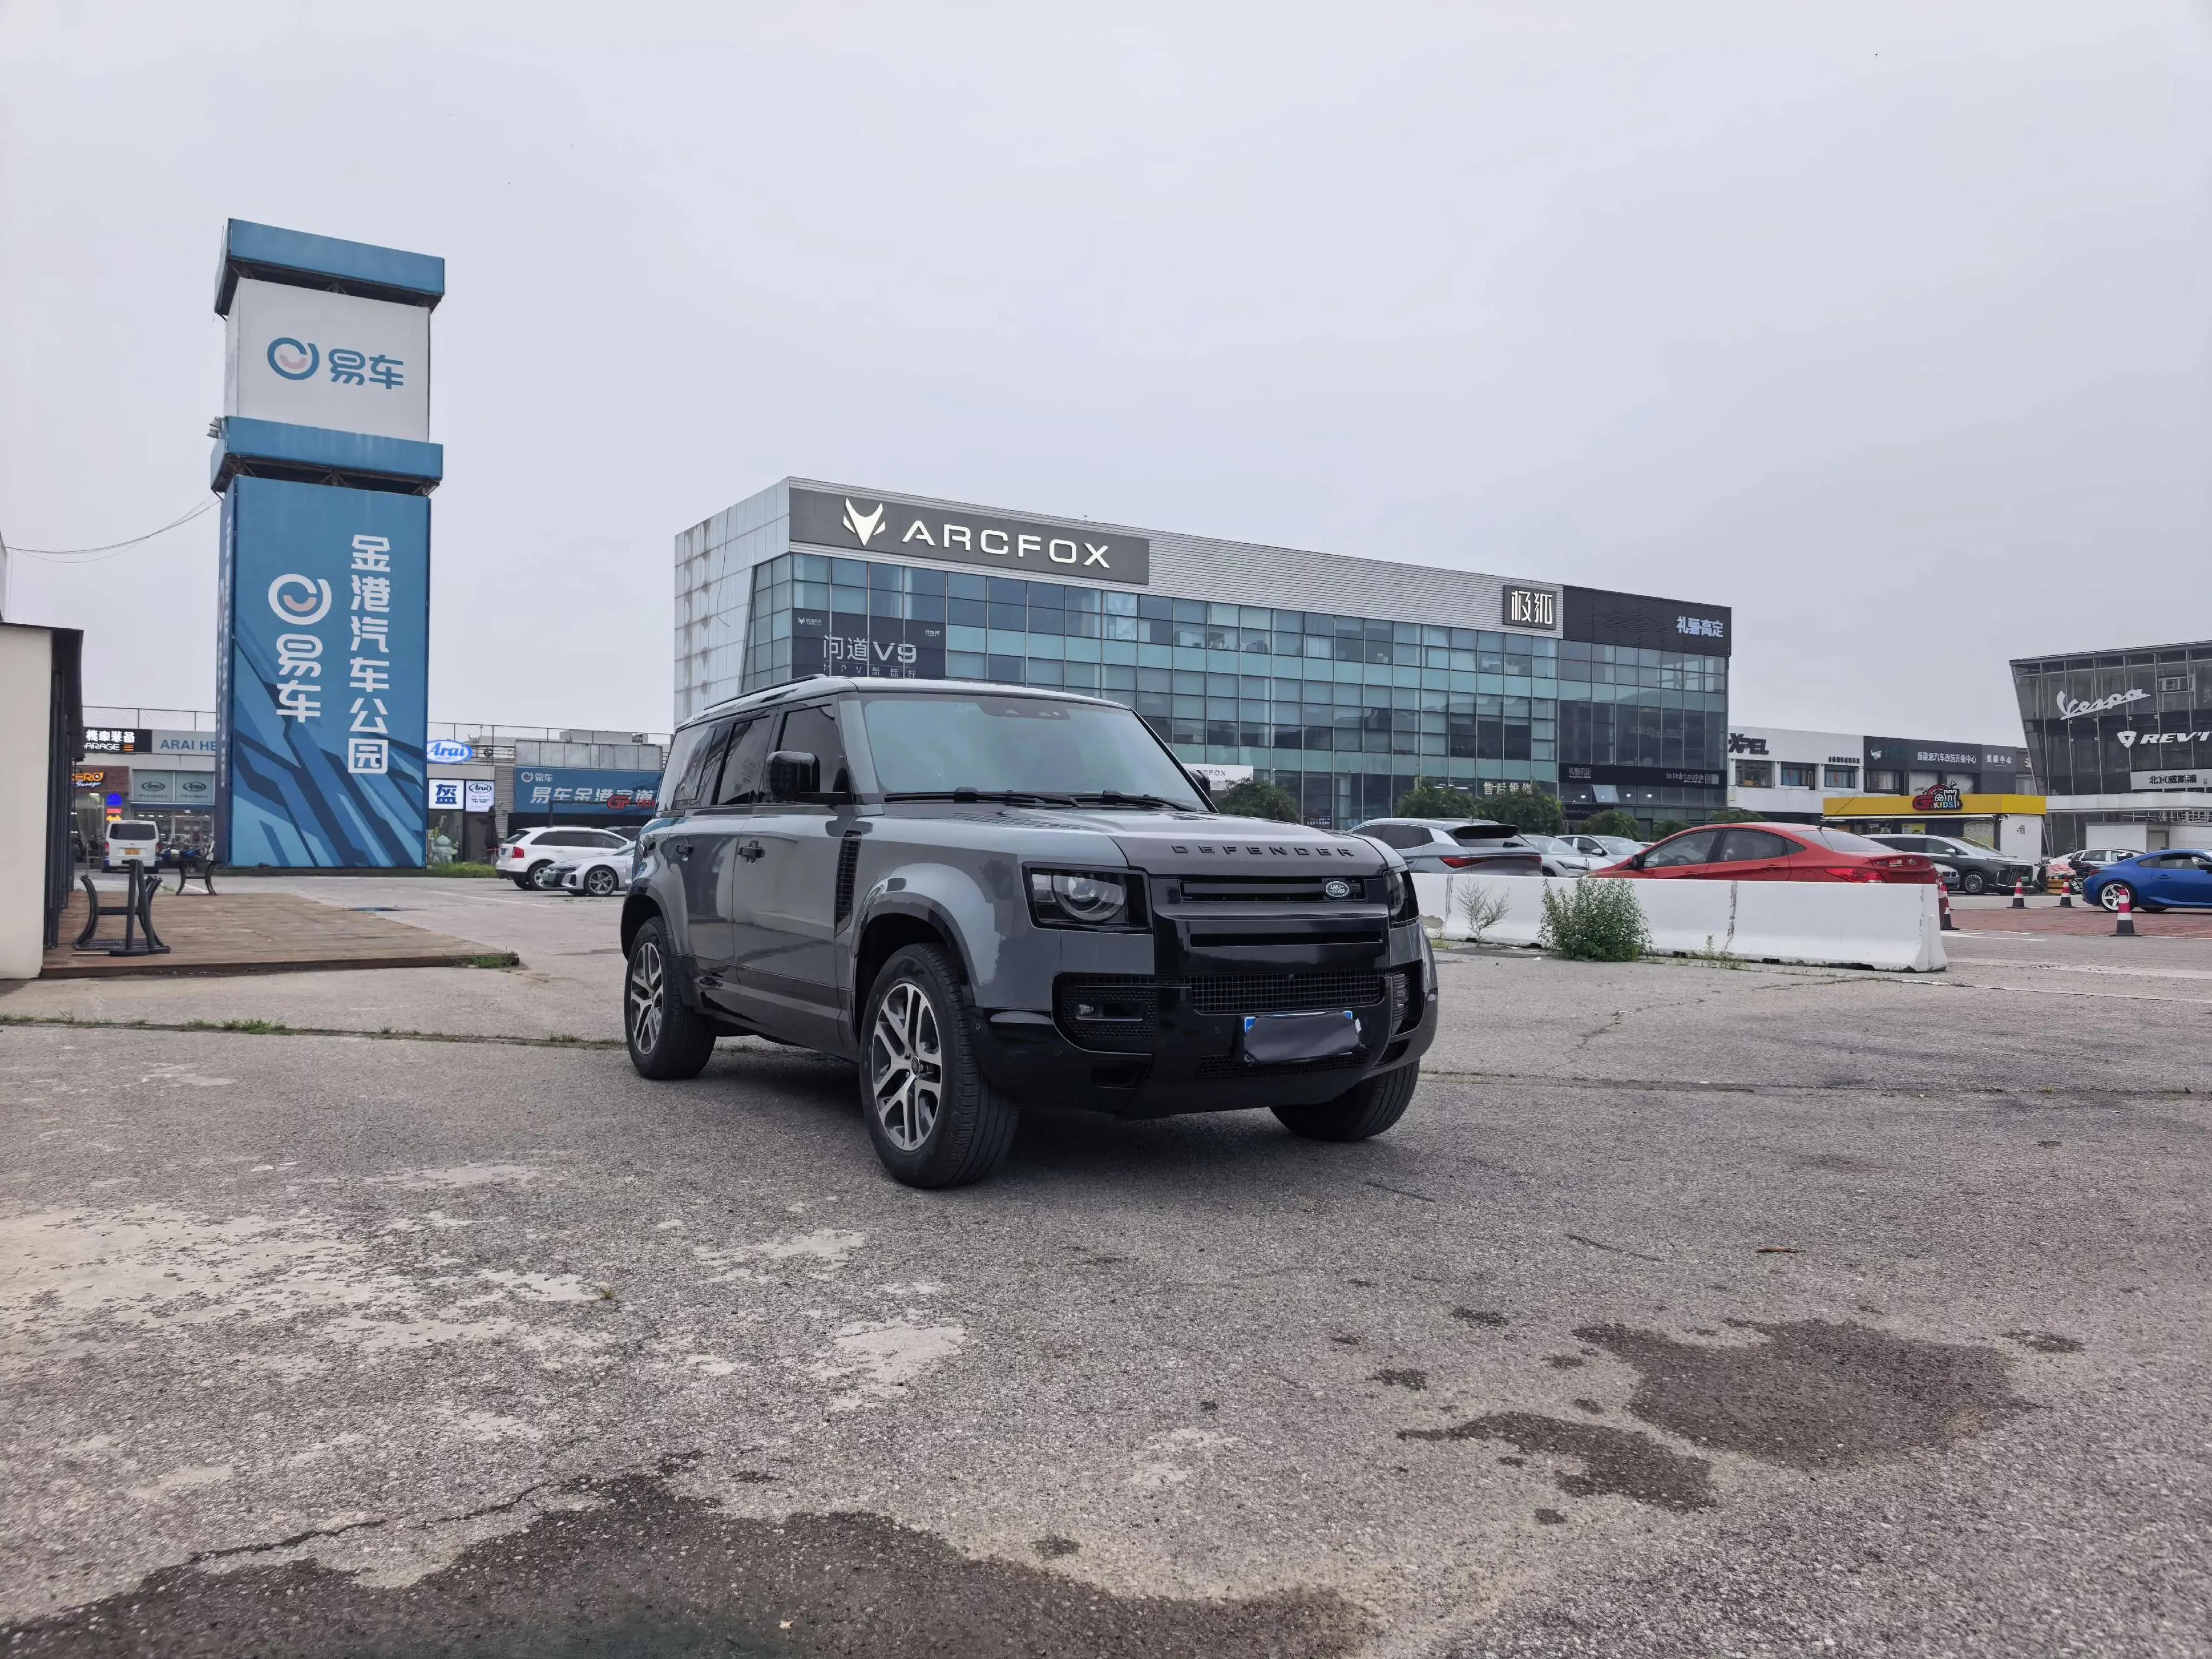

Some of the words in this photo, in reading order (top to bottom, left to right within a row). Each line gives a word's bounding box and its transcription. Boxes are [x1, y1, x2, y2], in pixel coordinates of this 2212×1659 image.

[328, 348, 404, 389] 易车
[902, 520, 1110, 569] ARCFOX
[1511, 590, 1553, 625] 极狐
[348, 534, 391, 774] 金港汽车公园
[276, 633, 323, 723] 易车
[2056, 689, 2152, 721] Vespa
[160, 739, 194, 750] ARAI
[428, 743, 465, 757] Arai
[1728, 733, 1770, 755] XPEL
[2140, 731, 2212, 744] REV'I
[535, 773, 553, 782] 易车
[1171, 845, 1354, 857] DEFENDER
